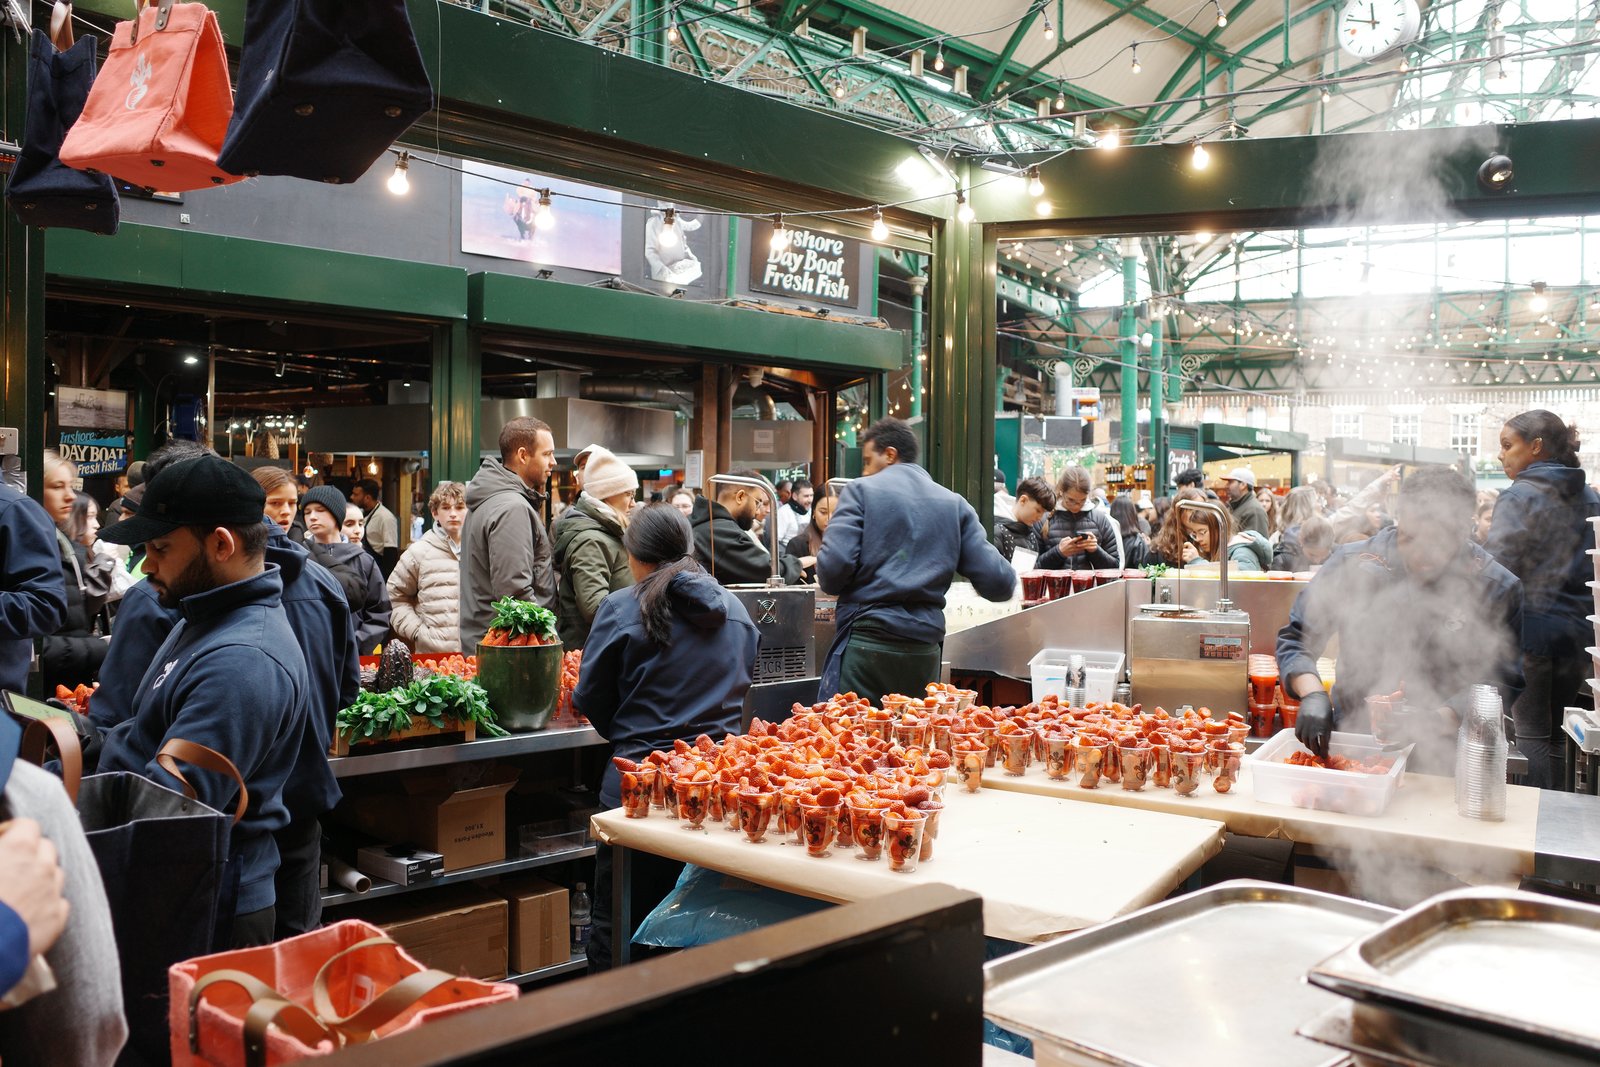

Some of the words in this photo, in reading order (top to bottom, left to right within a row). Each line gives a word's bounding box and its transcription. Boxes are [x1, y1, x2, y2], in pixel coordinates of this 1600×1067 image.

[779, 229, 845, 256] nshore
[767, 248, 805, 273] Day
[803, 248, 845, 277] Boat
[763, 263, 814, 293] Fresh
[815, 273, 850, 300] Fish
[60, 430, 94, 444] Inshore
[59, 443, 89, 462] DAY
[89, 446, 127, 462] BOAT
[77, 463, 101, 476] Fresh
